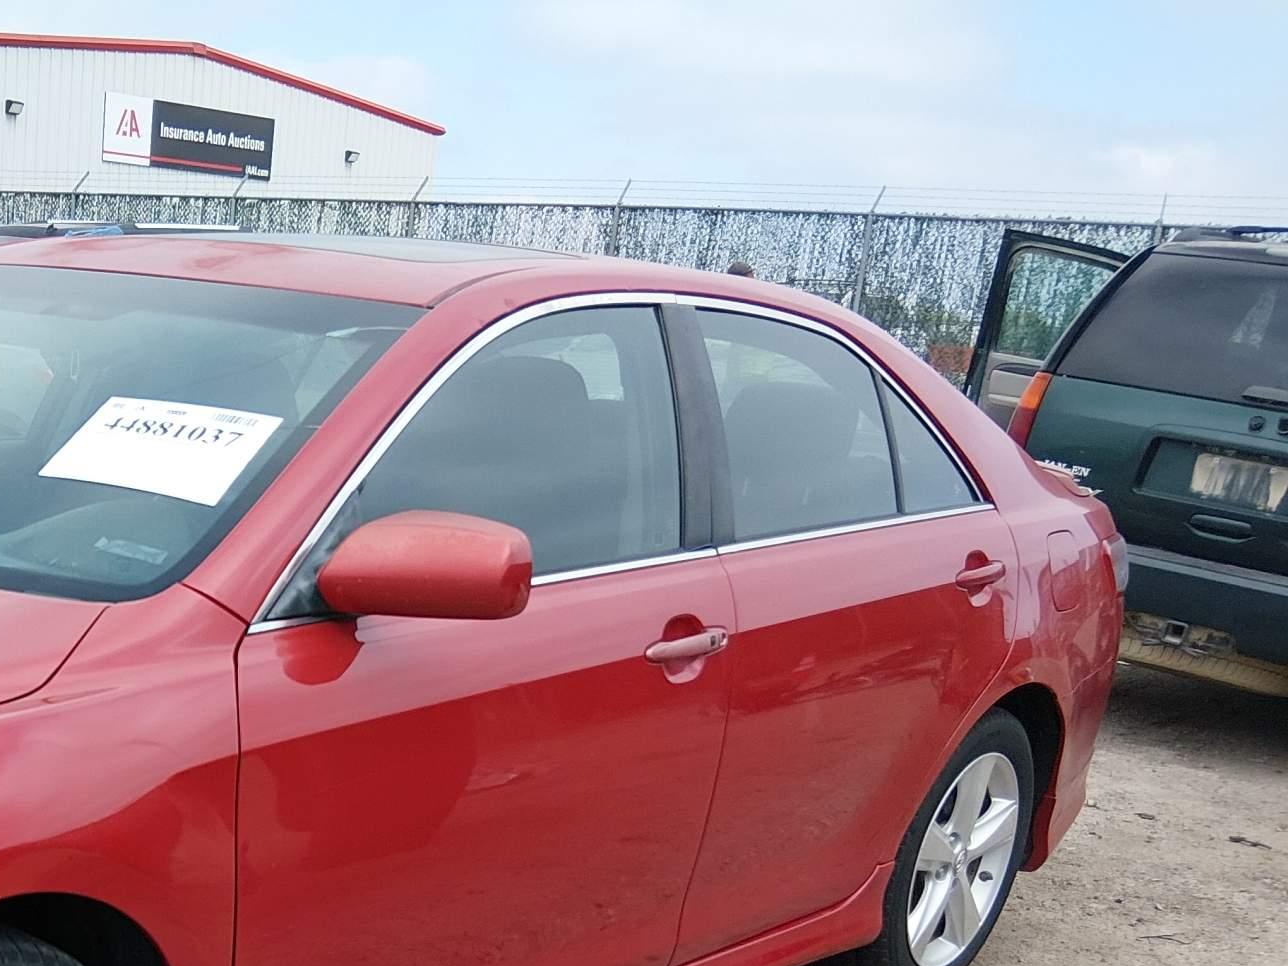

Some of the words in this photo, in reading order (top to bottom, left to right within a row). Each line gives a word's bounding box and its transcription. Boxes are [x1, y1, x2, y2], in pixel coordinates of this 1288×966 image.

[160, 122, 205, 143] Insurance
[206, 128, 227, 147] Auto
[228, 132, 265, 152] Auctions
[104, 416, 245, 448] 44881037
